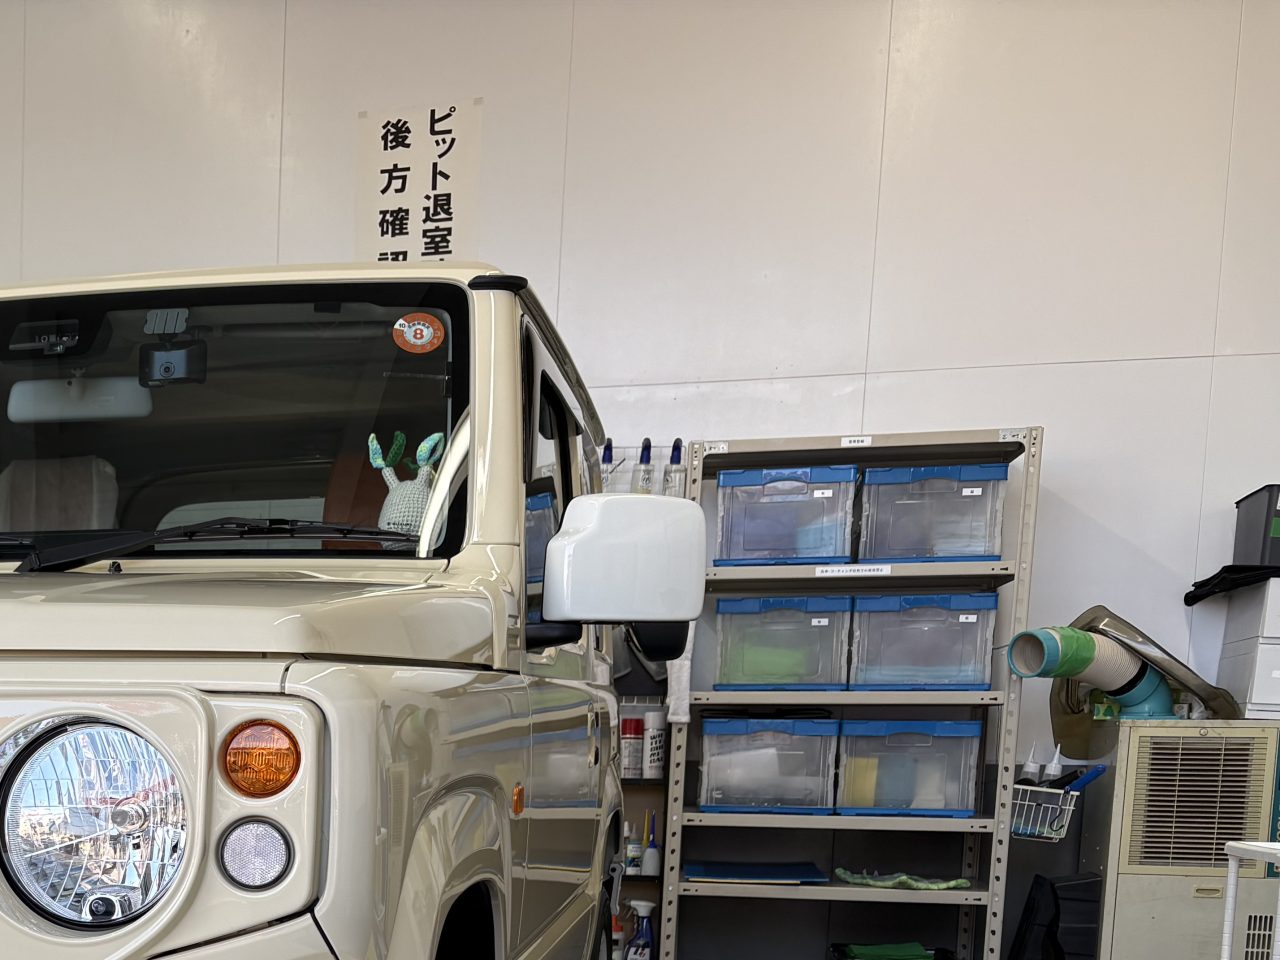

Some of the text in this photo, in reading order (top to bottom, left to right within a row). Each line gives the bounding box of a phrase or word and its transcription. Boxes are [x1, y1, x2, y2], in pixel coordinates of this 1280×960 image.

[421, 105, 457, 261] ピット退室
[413, 327, 425, 340] 8
